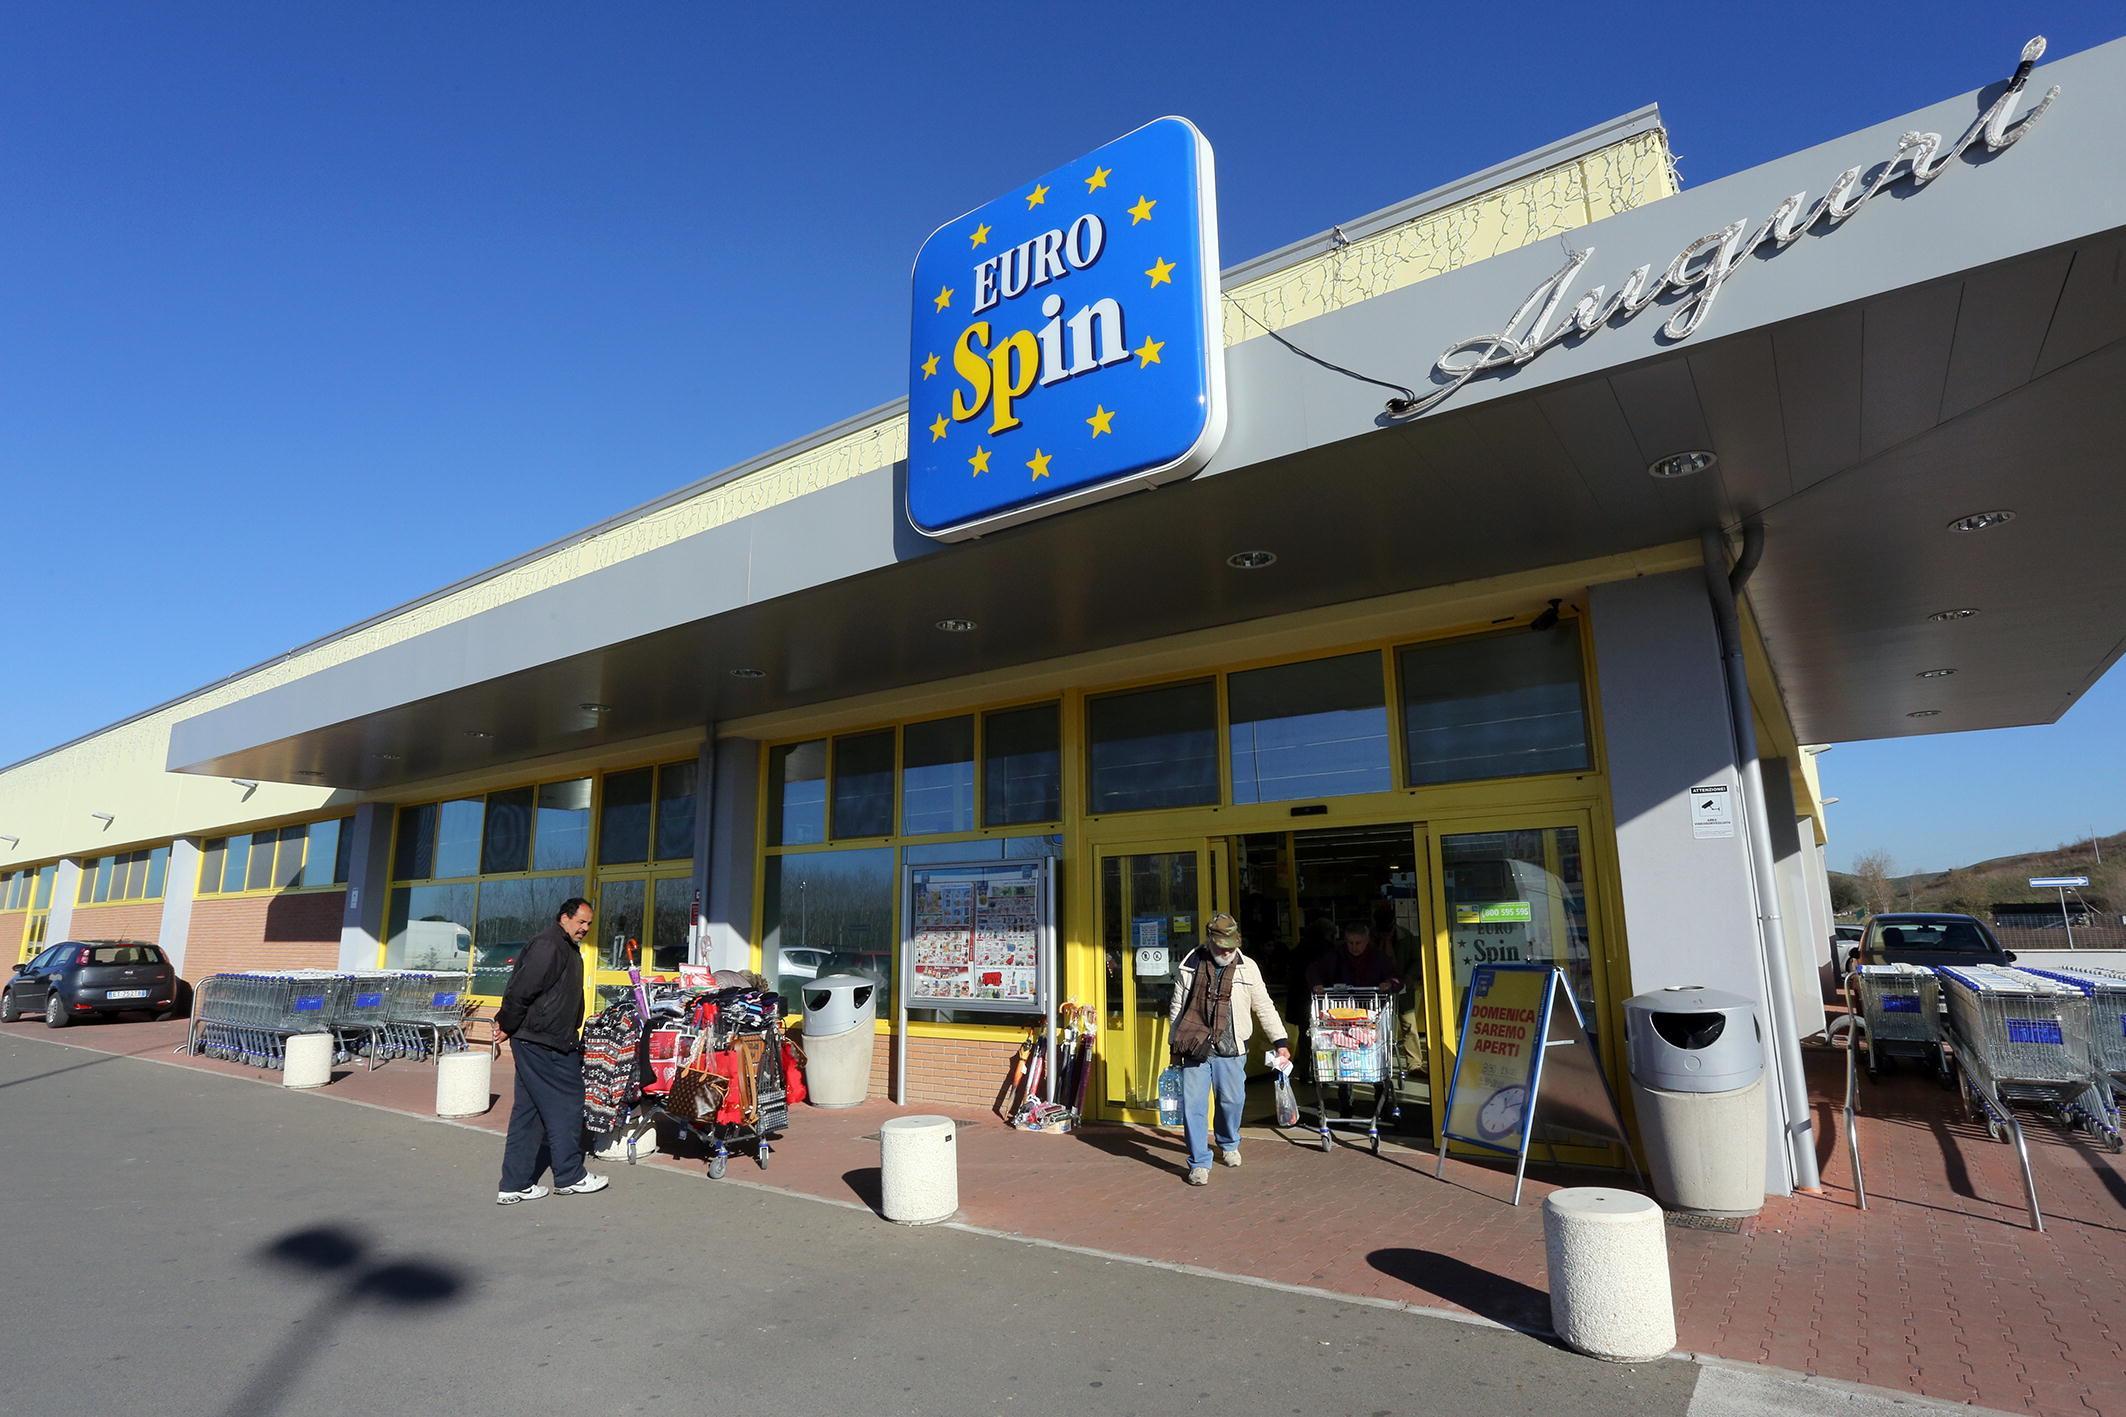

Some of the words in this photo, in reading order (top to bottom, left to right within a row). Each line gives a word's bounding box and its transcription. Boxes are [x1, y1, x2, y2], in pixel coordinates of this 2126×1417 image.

[972, 213, 1104, 315] EURO
[952, 293, 1130, 436] Spin
[1485, 909, 1499, 917] 800
[1501, 908, 1514, 916] 595
[1516, 908, 1529, 916] 595
[1478, 922, 1513, 935] EURO
[1473, 939, 1521, 965] Spin
[1471, 1005, 1536, 1024] DOMENICA
[1473, 1022, 1526, 1041] SAREMO
[1473, 1038, 1520, 1057] APERTI
